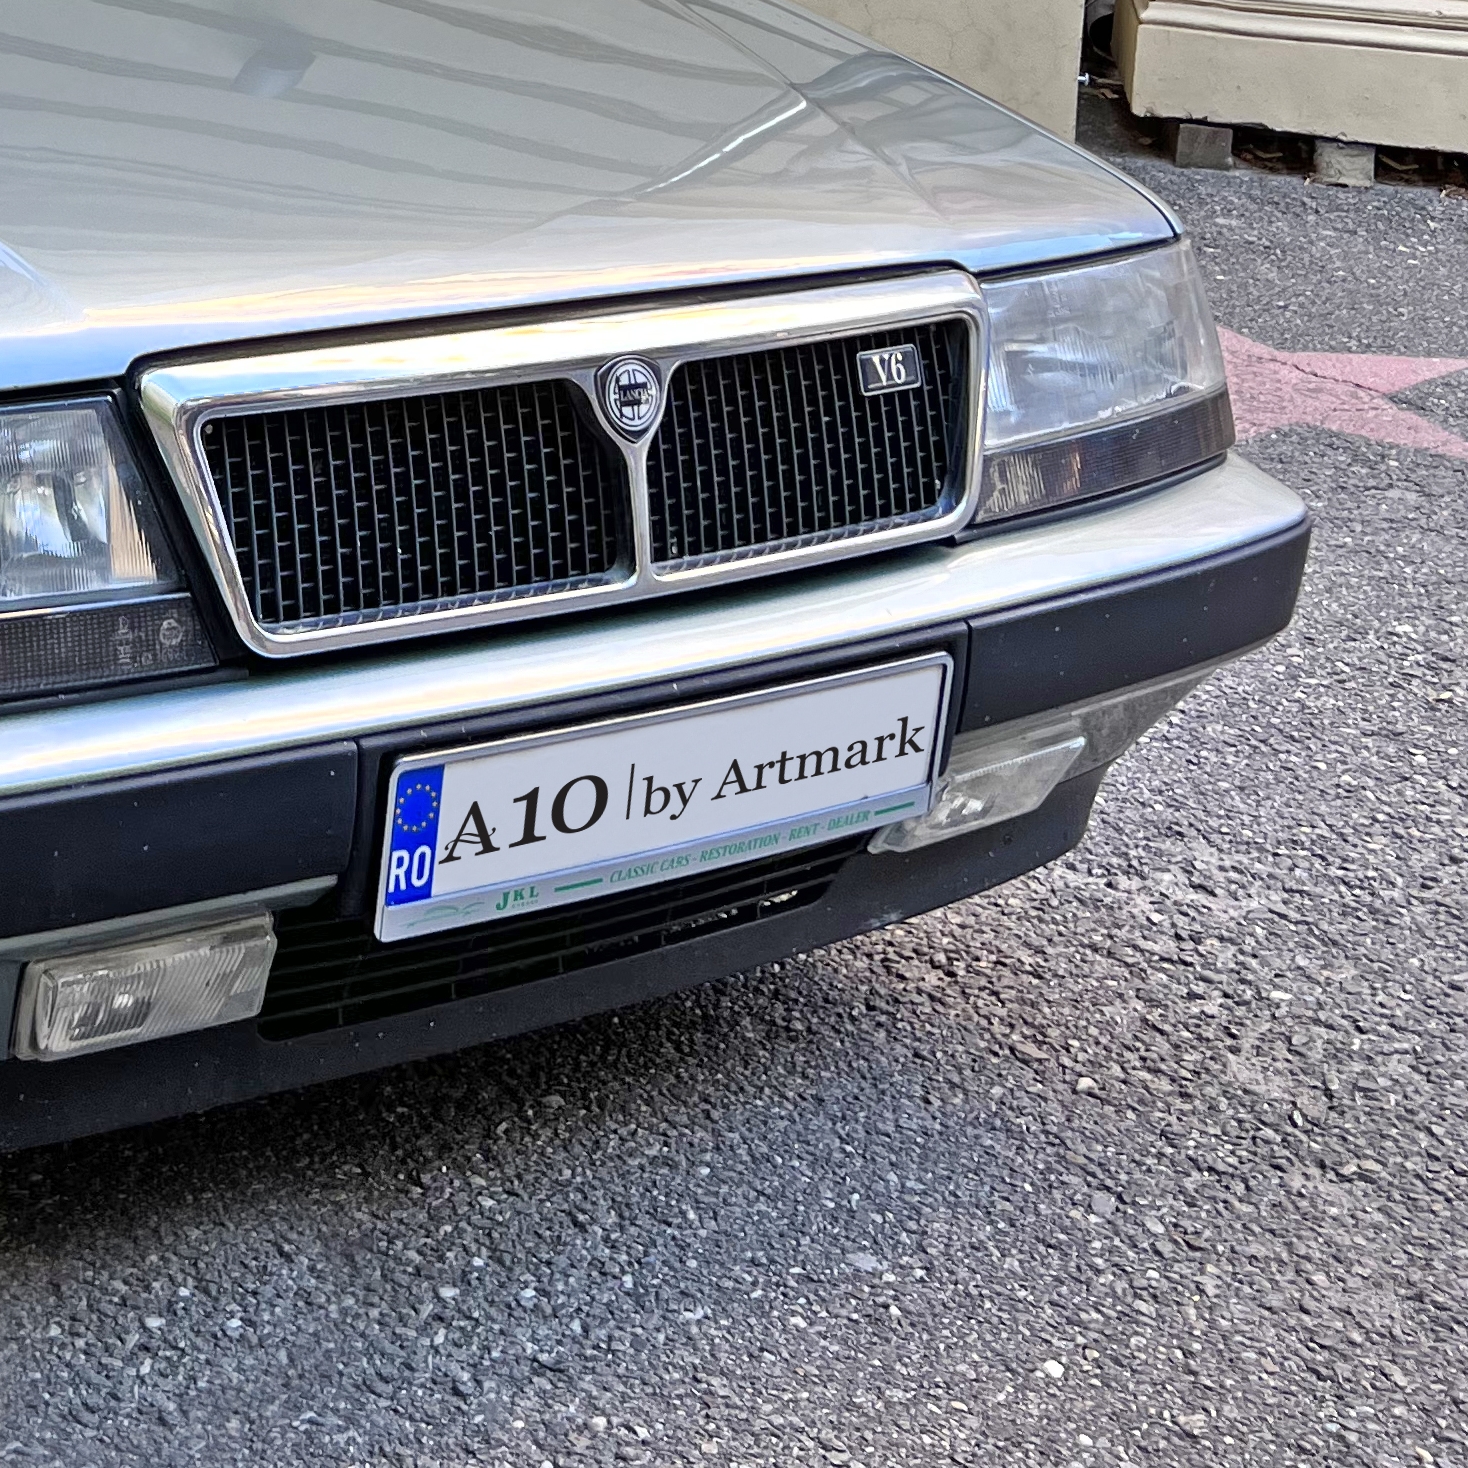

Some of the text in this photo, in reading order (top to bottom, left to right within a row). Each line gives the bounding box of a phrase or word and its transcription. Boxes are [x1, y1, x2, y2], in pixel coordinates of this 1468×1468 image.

[872, 352, 906, 386] V6
[643, 776, 702, 821] by
[710, 716, 924, 800] Artmark
[388, 845, 432, 893] RO
[609, 809, 872, 884] CLASSIC CARS RESTORATION RENT DEALER
[496, 885, 539, 911] JKL
